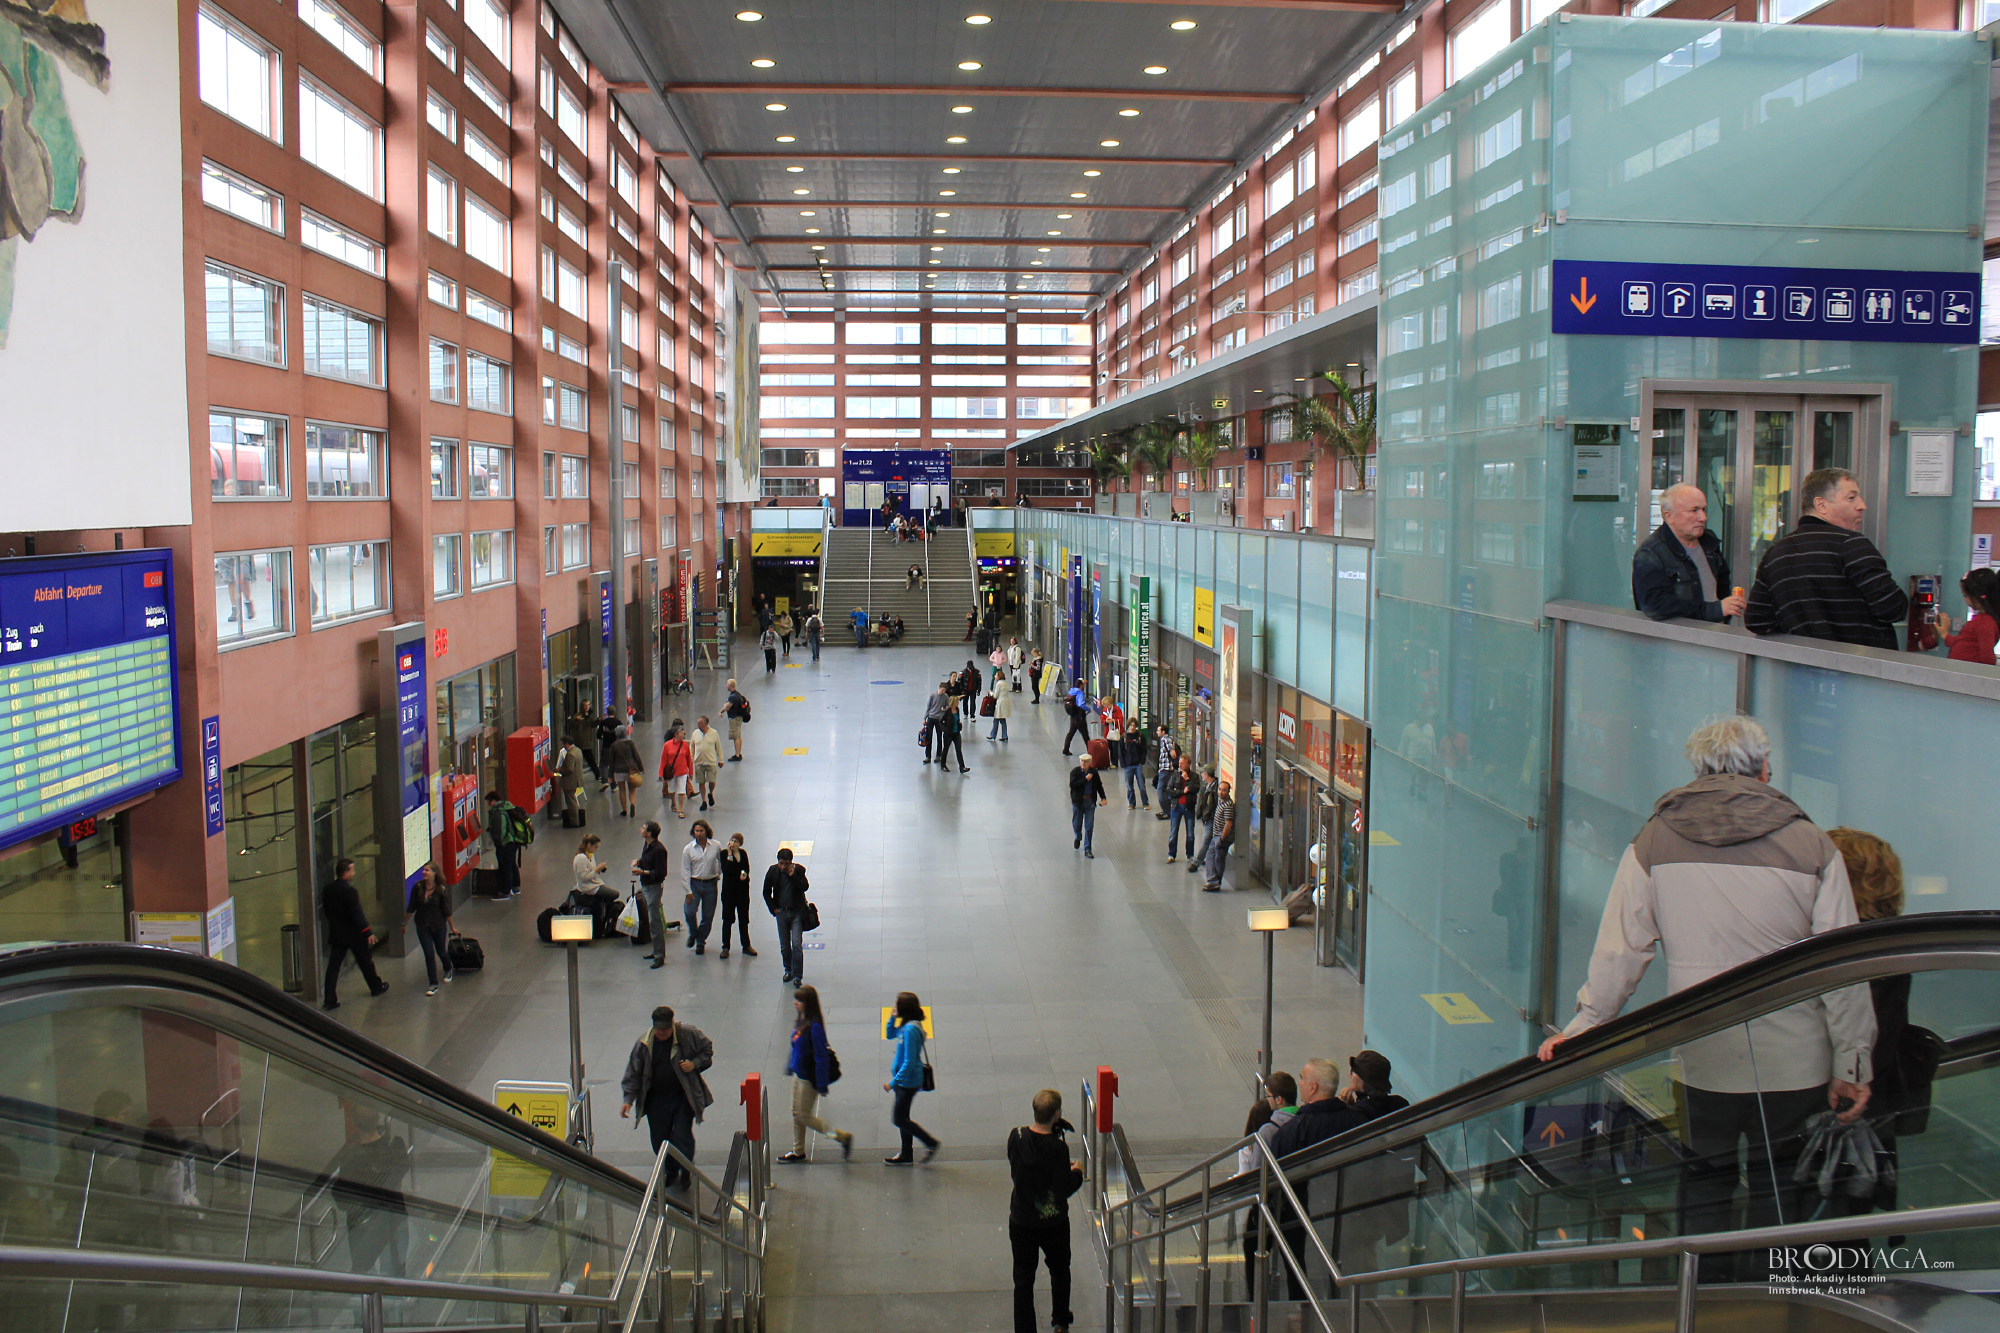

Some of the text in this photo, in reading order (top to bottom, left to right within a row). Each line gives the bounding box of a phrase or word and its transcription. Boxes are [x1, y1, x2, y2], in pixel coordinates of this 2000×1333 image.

[34, 584, 102, 602] Abfahrt Departure
[146, 616, 165, 628] Platform
[6, 622, 44, 639] Zug nach
[6, 640, 22, 652] Train
[30, 638, 38, 648] to
[32, 660, 53, 672] Verona
[1139, 602, 1149, 729] www.innsbruck-ticket-service.at
[34, 692, 44, 704] Hall
[36, 722, 56, 736] Lindau
[1279, 711, 1296, 740] LOTTO
[1304, 720, 1356, 788] TABAK
[210, 802, 219, 814] WC
[71, 817, 95, 840] 15:32
